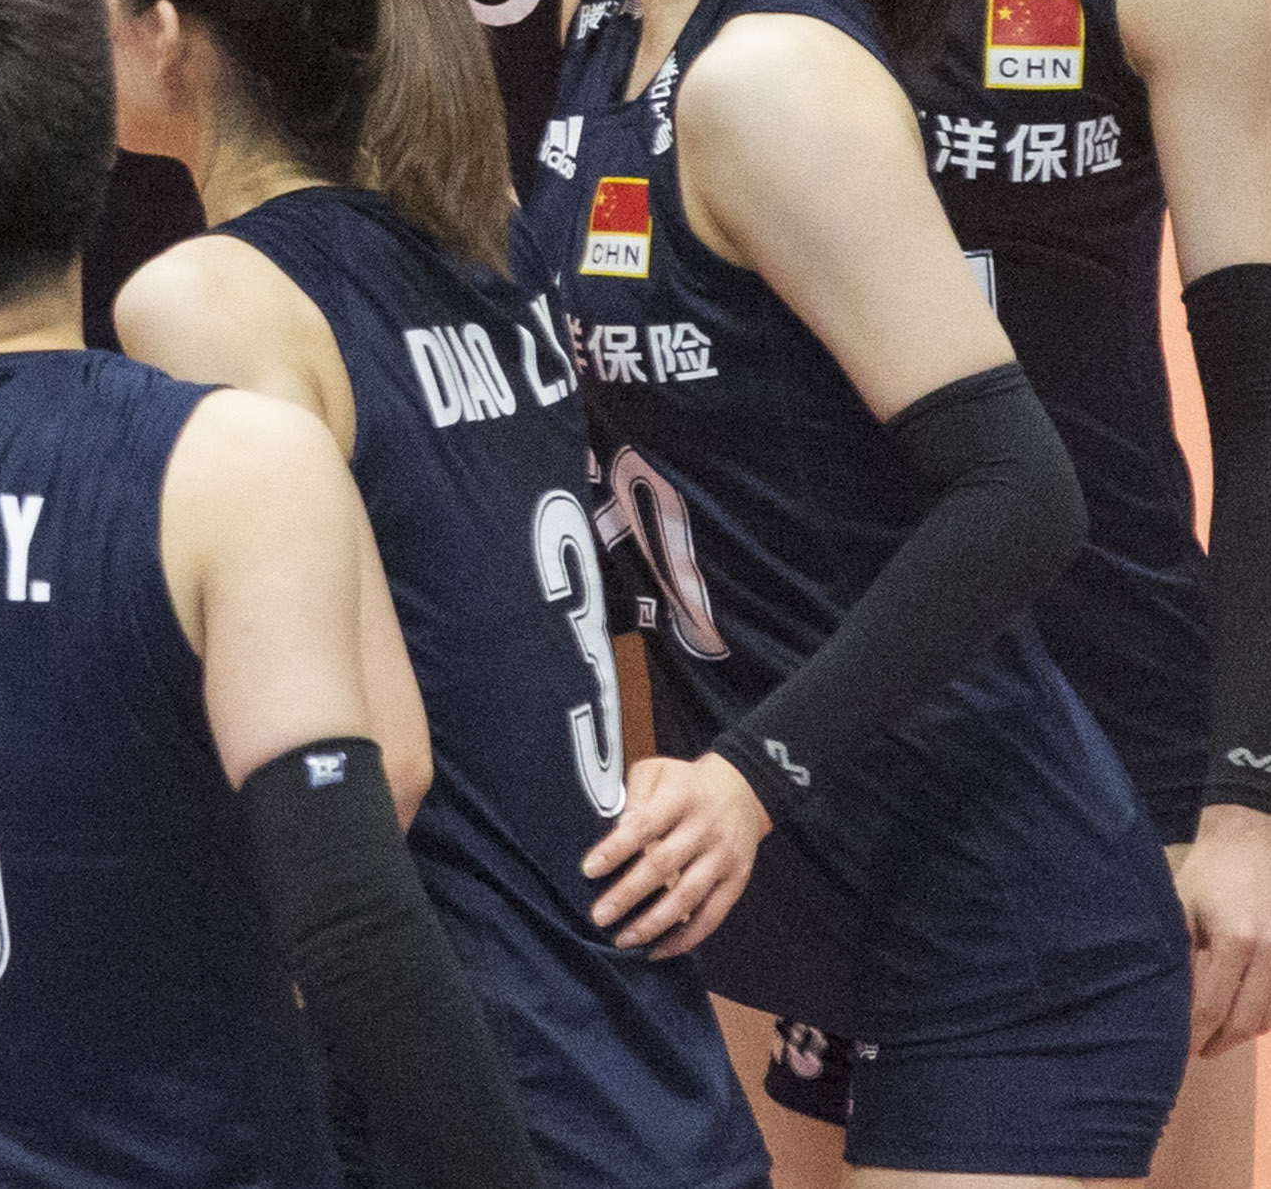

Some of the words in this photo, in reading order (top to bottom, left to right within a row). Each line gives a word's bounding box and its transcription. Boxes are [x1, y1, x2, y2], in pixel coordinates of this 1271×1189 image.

[999, 57, 1072, 78] CHN
[591, 242, 641, 267] CHN
[405, 322, 517, 429] DIAO
[533, 488, 626, 818] 3
